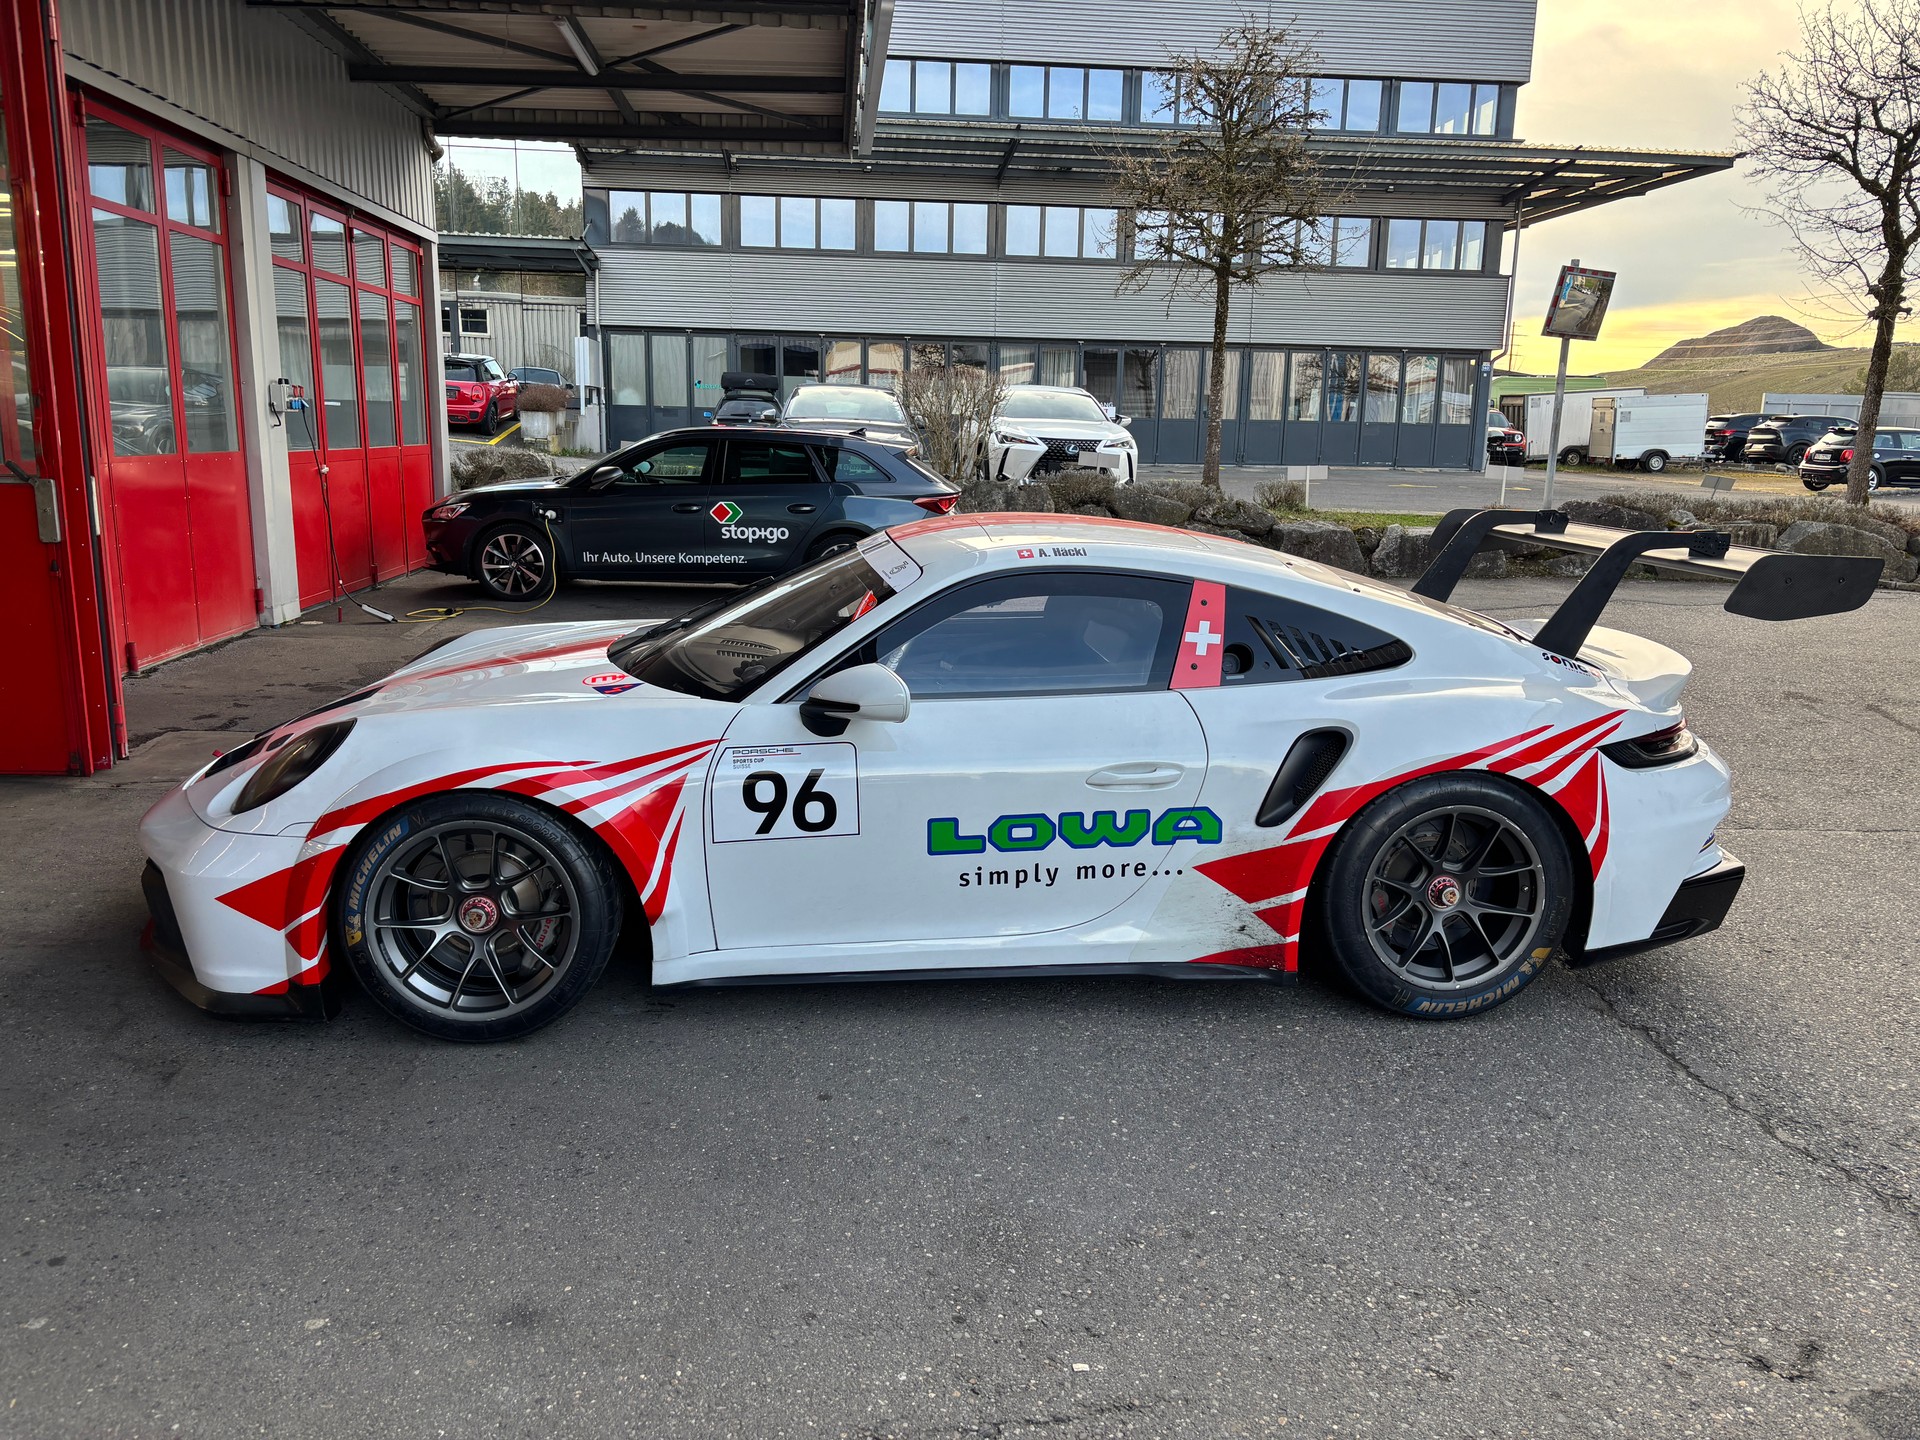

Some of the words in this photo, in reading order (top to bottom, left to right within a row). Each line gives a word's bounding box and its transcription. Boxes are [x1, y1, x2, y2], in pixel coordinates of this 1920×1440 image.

[721, 524, 789, 543] stop+go
[583, 551, 599, 563] Ihr
[602, 552, 633, 563] Auto.
[635, 552, 676, 563] Unsere
[678, 552, 748, 566] Kompetenz.
[1038, 548, 1051, 557] A.
[732, 747, 794, 755] PORSCHE
[742, 768, 838, 835] 96
[926, 806, 1223, 856] LOWA
[348, 823, 403, 911] MICHELIN
[959, 863, 1060, 889] simply
[1076, 861, 1184, 880] more...
[535, 917, 554, 950] bremb
[1416, 975, 1520, 1014] MICHELIN
